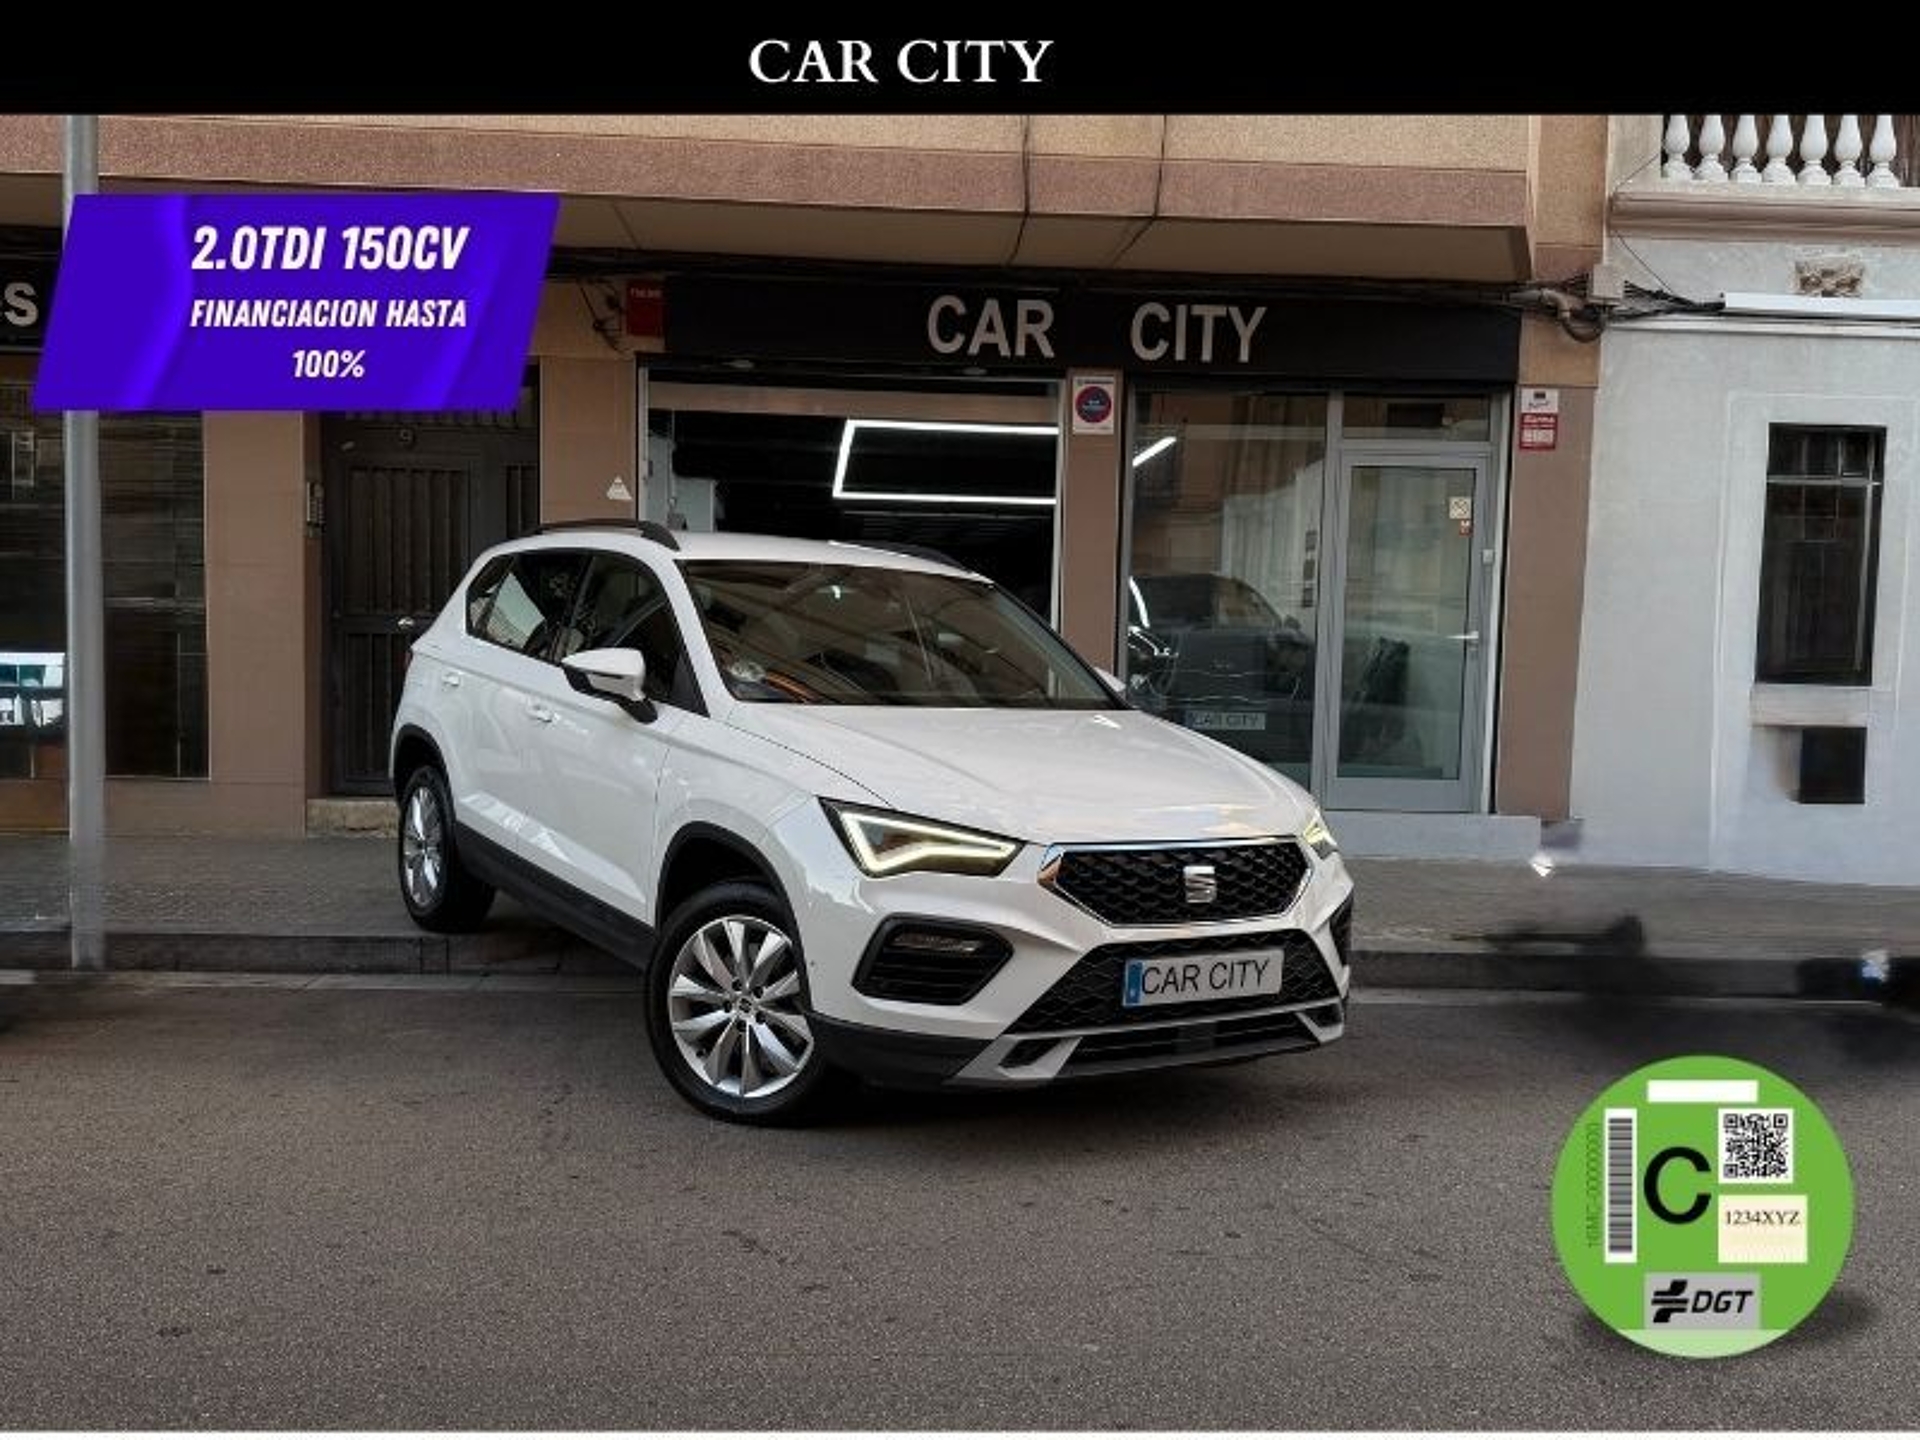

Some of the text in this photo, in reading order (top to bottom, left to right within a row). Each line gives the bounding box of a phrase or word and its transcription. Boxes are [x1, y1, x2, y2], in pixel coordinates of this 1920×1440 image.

[927, 295, 1267, 363] CAR CITY
[1141, 958, 1270, 994] CAR CITY
